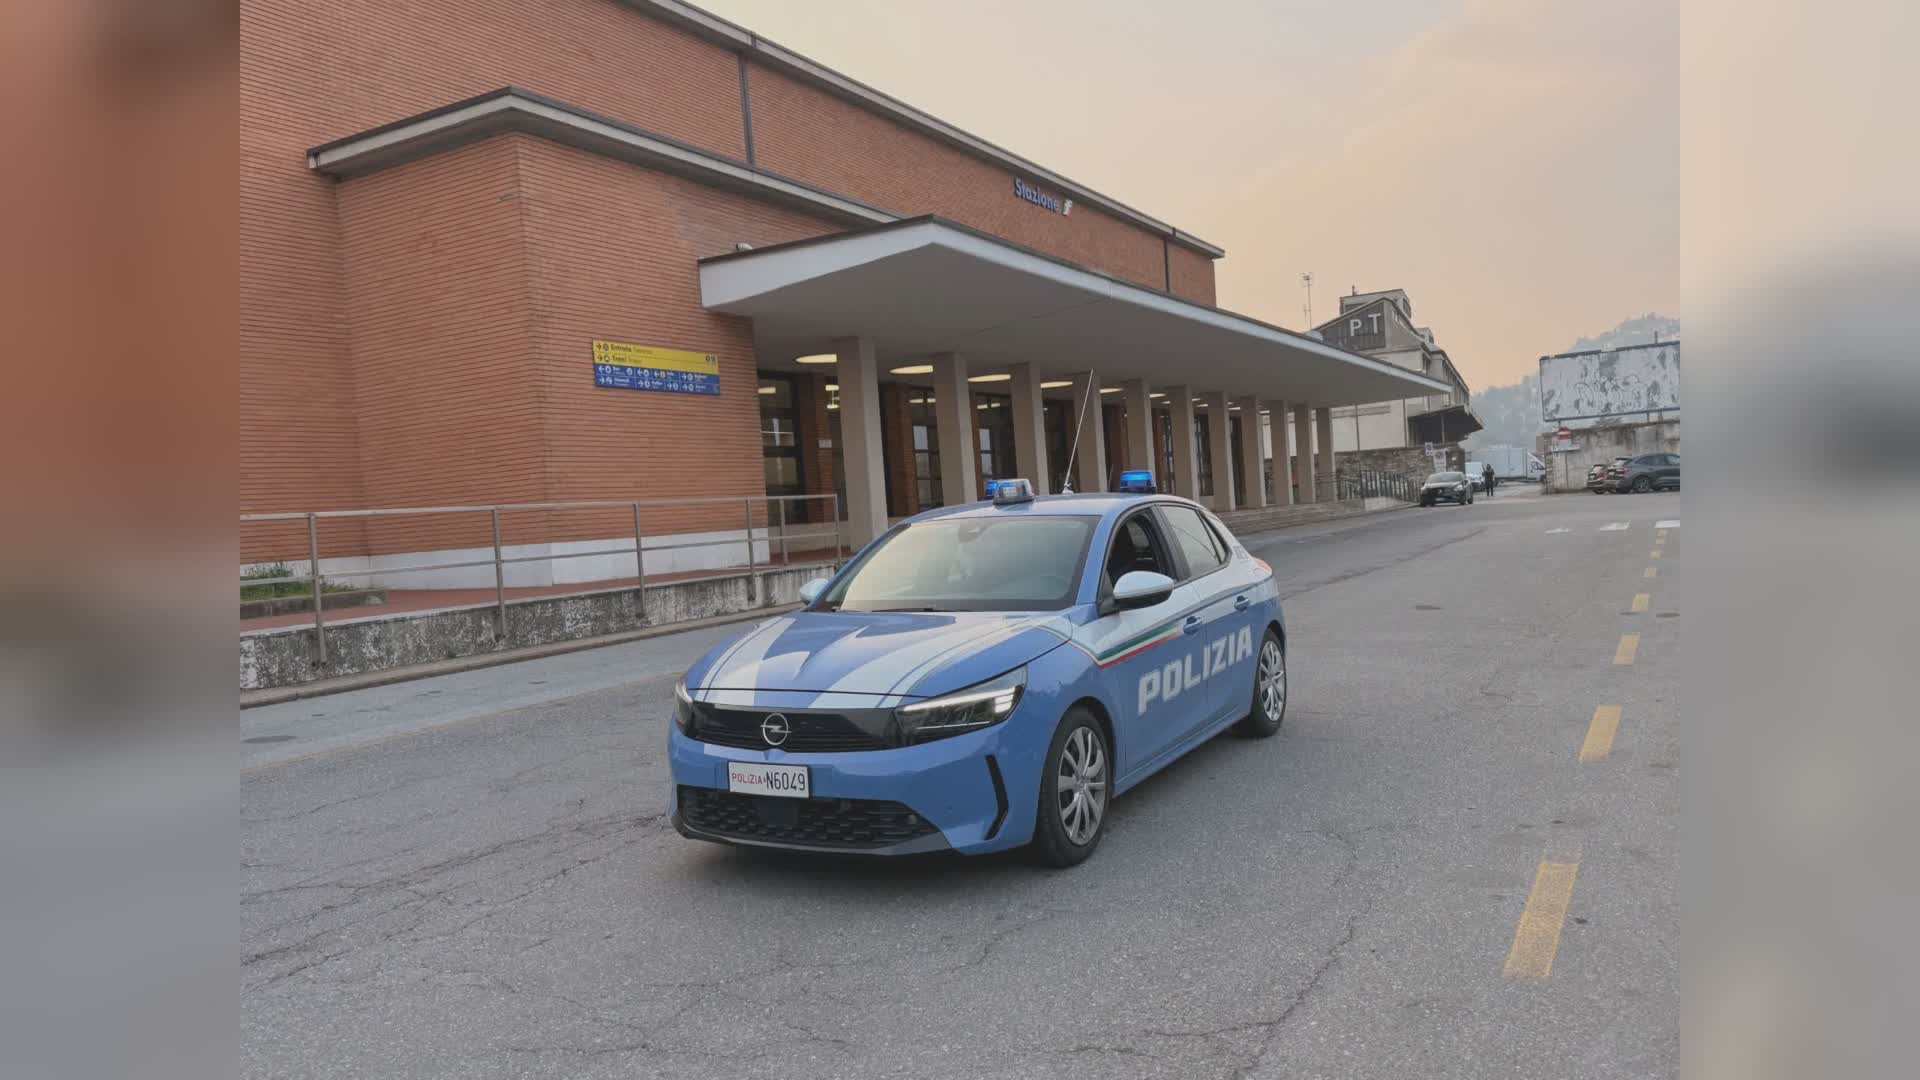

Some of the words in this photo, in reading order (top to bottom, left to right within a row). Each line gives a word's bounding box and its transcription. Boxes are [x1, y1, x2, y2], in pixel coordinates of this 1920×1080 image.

[1015, 177, 1059, 213] Stazione
[1138, 624, 1252, 715] POLIZIA
[731, 772, 763, 785] POLIZIA
[765, 770, 806, 791] N6049
